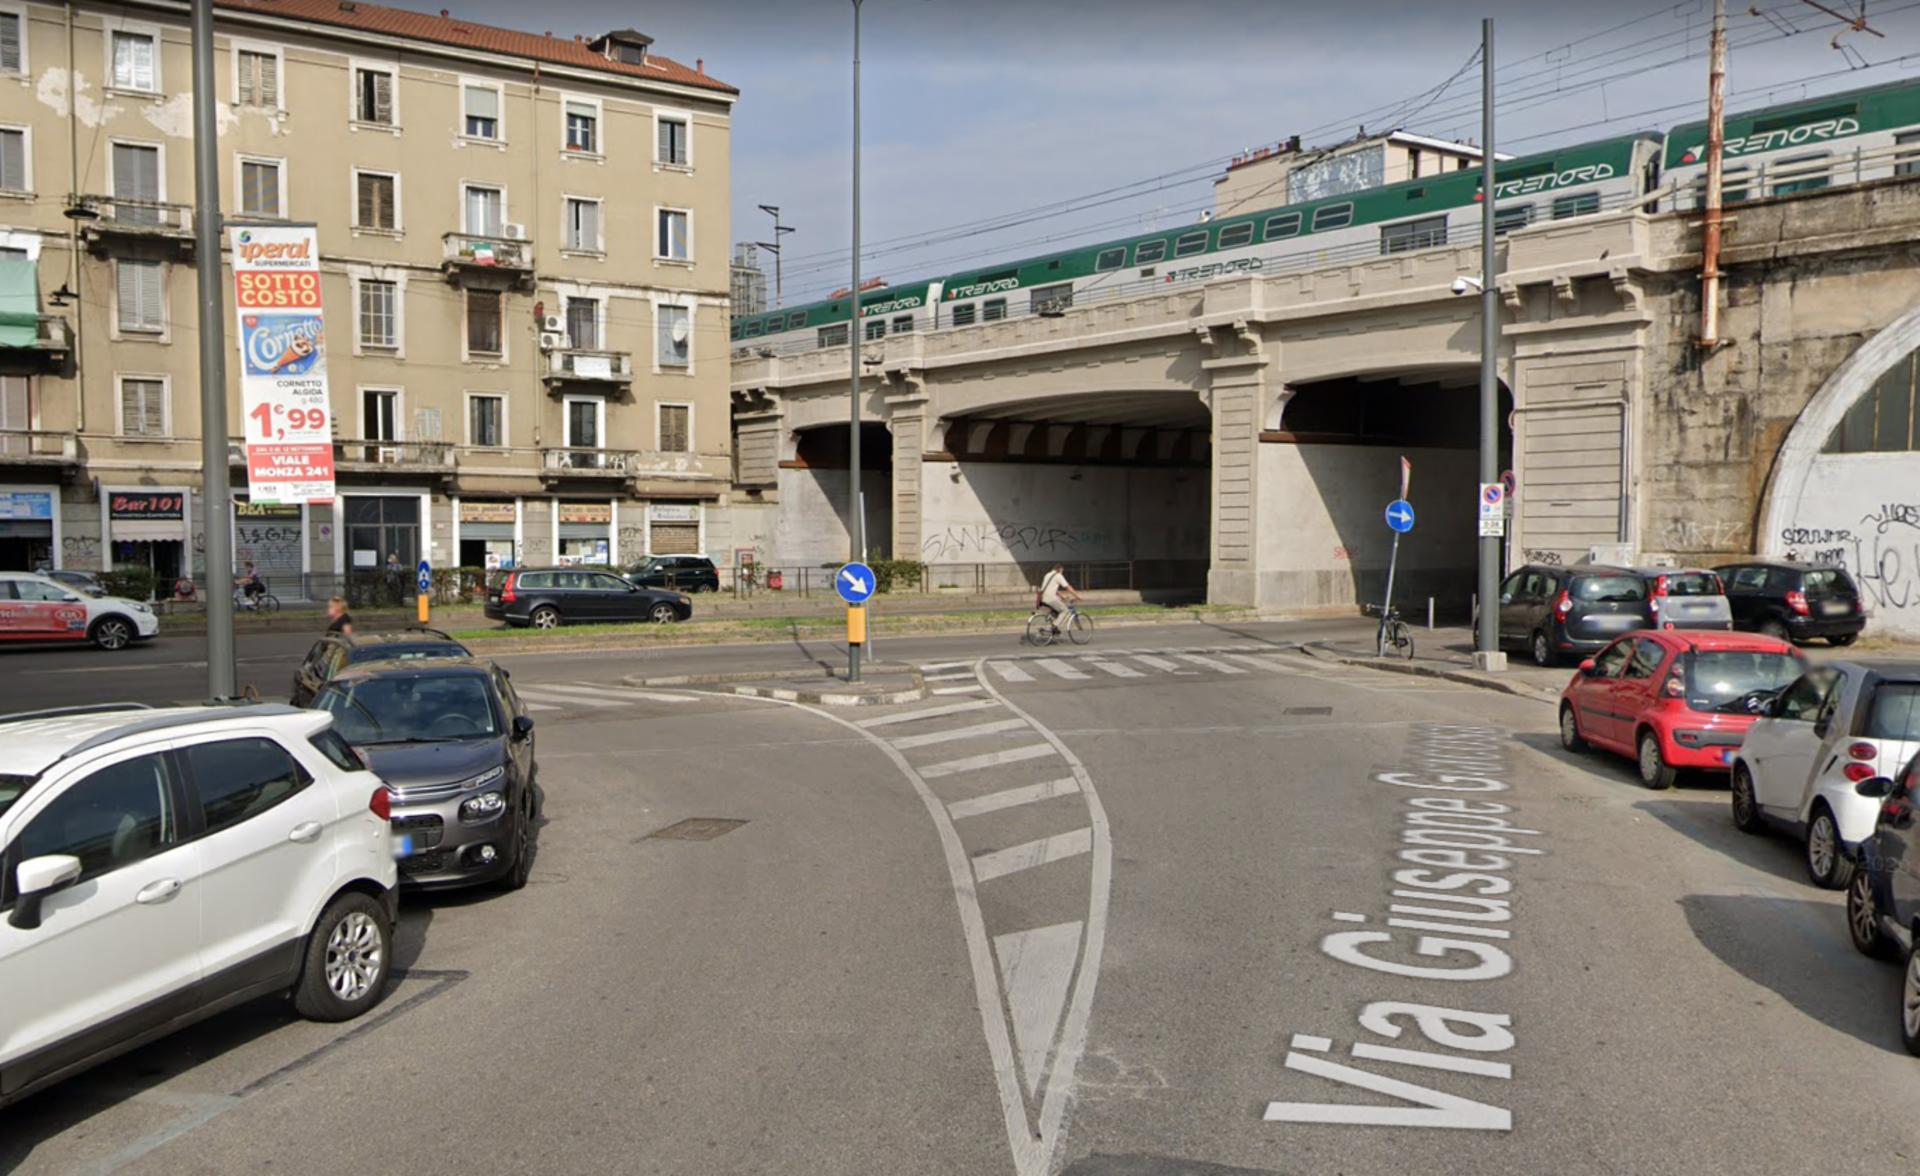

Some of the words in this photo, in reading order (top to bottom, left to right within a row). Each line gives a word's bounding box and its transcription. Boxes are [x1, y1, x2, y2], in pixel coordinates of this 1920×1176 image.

[1722, 118, 1860, 154] RENORD
[1494, 163, 1614, 198] TRENORD
[239, 237, 310, 263] iperal
[1178, 257, 1263, 281] TRENORD
[240, 272, 316, 290] SOTTO
[957, 277, 1019, 297] TRENORD
[241, 289, 318, 306] COSTO
[867, 296, 921, 315] TRENORD
[276, 380, 322, 388] CORNETTO
[292, 388, 323, 396] ALGIDA
[271, 455, 310, 465] VIALE
[254, 466, 304, 477] MONZA
[305, 466, 329, 477] 241
[112, 496, 148, 511] Bar
[150, 496, 182, 512] 101
